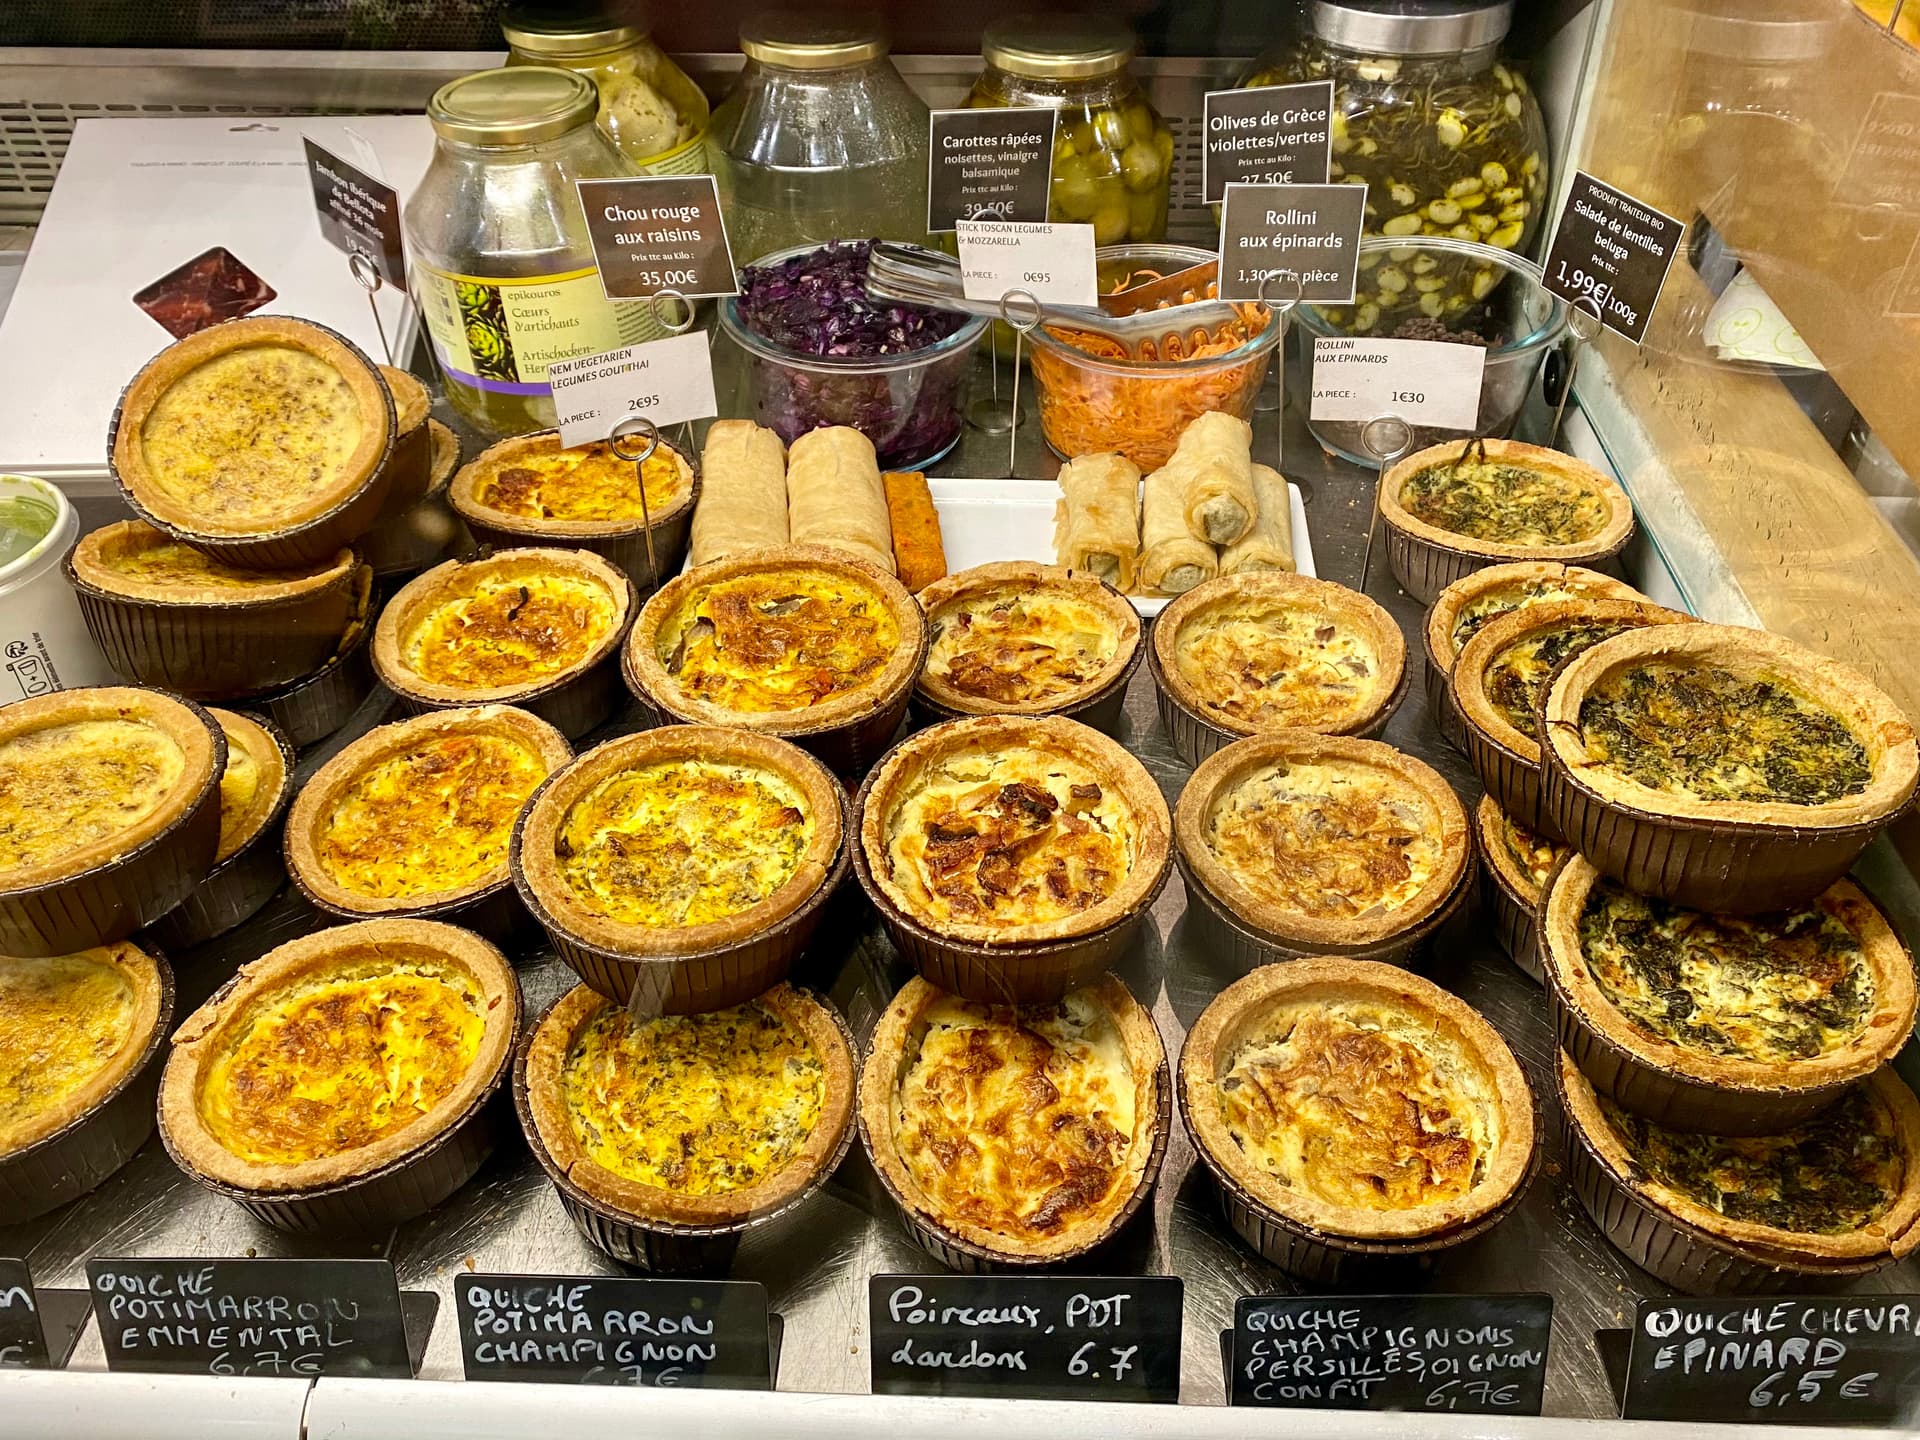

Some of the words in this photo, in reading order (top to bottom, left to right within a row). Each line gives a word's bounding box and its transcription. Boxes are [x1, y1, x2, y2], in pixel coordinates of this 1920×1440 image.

[1210, 115, 1257, 131] Olives
[1260, 111, 1279, 127] de
[1282, 107, 1326, 123] Grèce
[943, 136, 998, 149] Carottes
[1000, 131, 1042, 146] râpées
[1209, 131, 1326, 152] violettes/vertes
[944, 152, 995, 164] noisettes,
[998, 150, 1039, 164] vinaigre
[1238, 157, 1252, 166] Prix
[1254, 157, 1263, 165] ttc
[1265, 156, 1276, 164] au
[1278, 154, 1291, 162] Kilo
[961, 167, 1020, 179] balsamique
[1241, 171, 1293, 184] 2750€
[331, 185, 342, 200] de
[962, 185, 976, 195] Prix
[1000, 184, 1014, 192] Kilo
[604, 205, 648, 222] Chou
[652, 206, 700, 222] rouge
[1588, 185, 1621, 208] PRODUIT
[1619, 200, 1651, 224] TRAITEUR
[1650, 218, 1664, 230] BIO
[1266, 209, 1317, 225] Rollini
[957, 223, 979, 232] STICK
[980, 224, 1012, 233] TOSCAN
[1014, 225, 1053, 234] LEGUMES
[1574, 200, 1607, 225] Salade
[1608, 219, 1621, 233] de
[1622, 224, 1664, 256] lentilles
[614, 233, 644, 245] aux
[647, 228, 701, 241] raisins
[967, 236, 1021, 246] MOZZARELLA
[1239, 235, 1268, 248] aux
[1272, 232, 1343, 252] épinards
[1594, 230, 1629, 260] beluga
[631, 253, 647, 262] Prix
[674, 252, 689, 260] Kilo
[1591, 254, 1604, 267] Prix
[1604, 261, 1615, 272] ttc
[639, 269, 698, 287] 35,00€
[1023, 272, 1050, 283] 0€95
[1302, 268, 1339, 285] pièce
[507, 288, 561, 300] epikouros
[511, 307, 550, 319] Cœurs
[1316, 340, 1355, 350] ROLLINI
[1314, 354, 1336, 363] AUX
[1338, 354, 1388, 364] EPINARDS
[549, 363, 572, 376] NEM
[552, 370, 597, 389] LEGUMES
[599, 365, 626, 378] GOUT
[627, 360, 649, 372] THAI
[1312, 390, 1323, 398] LA
[1325, 390, 1350, 398] PIECE
[1391, 391, 1425, 404] 1€30
[628, 395, 660, 411] 2€95
[559, 418, 570, 426] LA
[571, 410, 595, 422] PIECE
[467, 1284, 593, 1313] QUICHE
[109, 1294, 359, 1321] POTIMARRON
[1246, 1309, 1360, 1332] QUICHE
[1645, 1302, 1797, 1338] QUICHE
[1800, 1303, 1920, 1337] CHEVR
[121, 1320, 353, 1350] EMMENTAL
[1654, 1337, 1847, 1375] EPINARD
[1253, 1377, 1387, 1401] CONFIT
